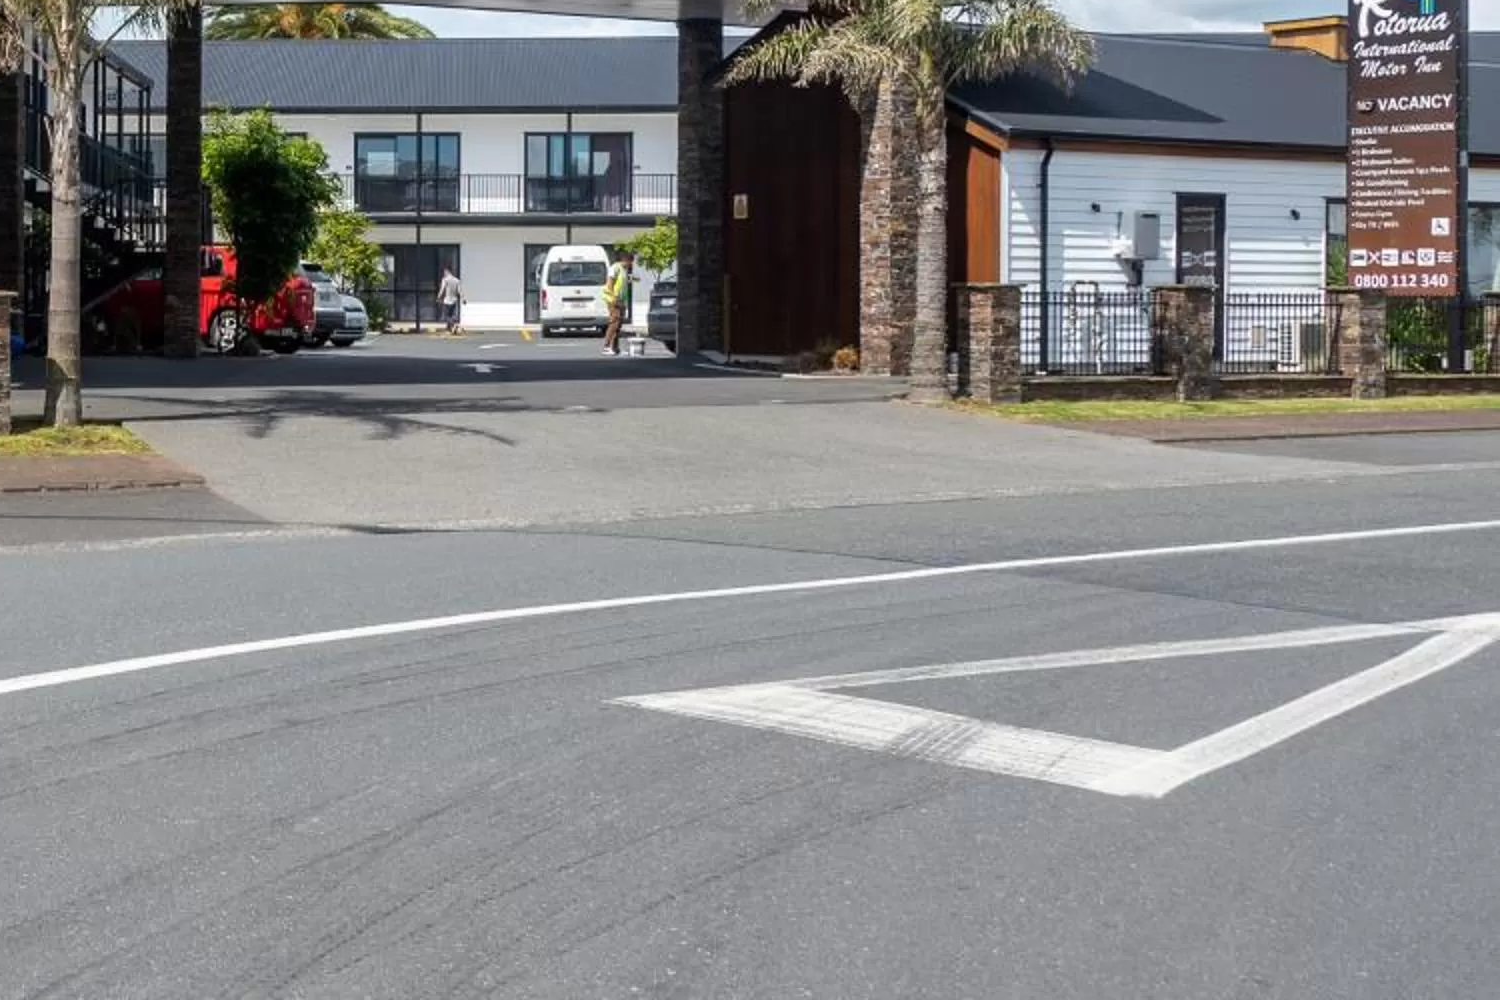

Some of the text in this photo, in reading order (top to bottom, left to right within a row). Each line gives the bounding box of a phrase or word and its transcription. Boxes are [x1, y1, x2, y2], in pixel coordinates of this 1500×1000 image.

[1353, 34, 1455, 59] International
[1360, 55, 1442, 78] Motor Inn
[1377, 93, 1453, 112] VACANCY
[1355, 274, 1449, 288] 0800 112 340
